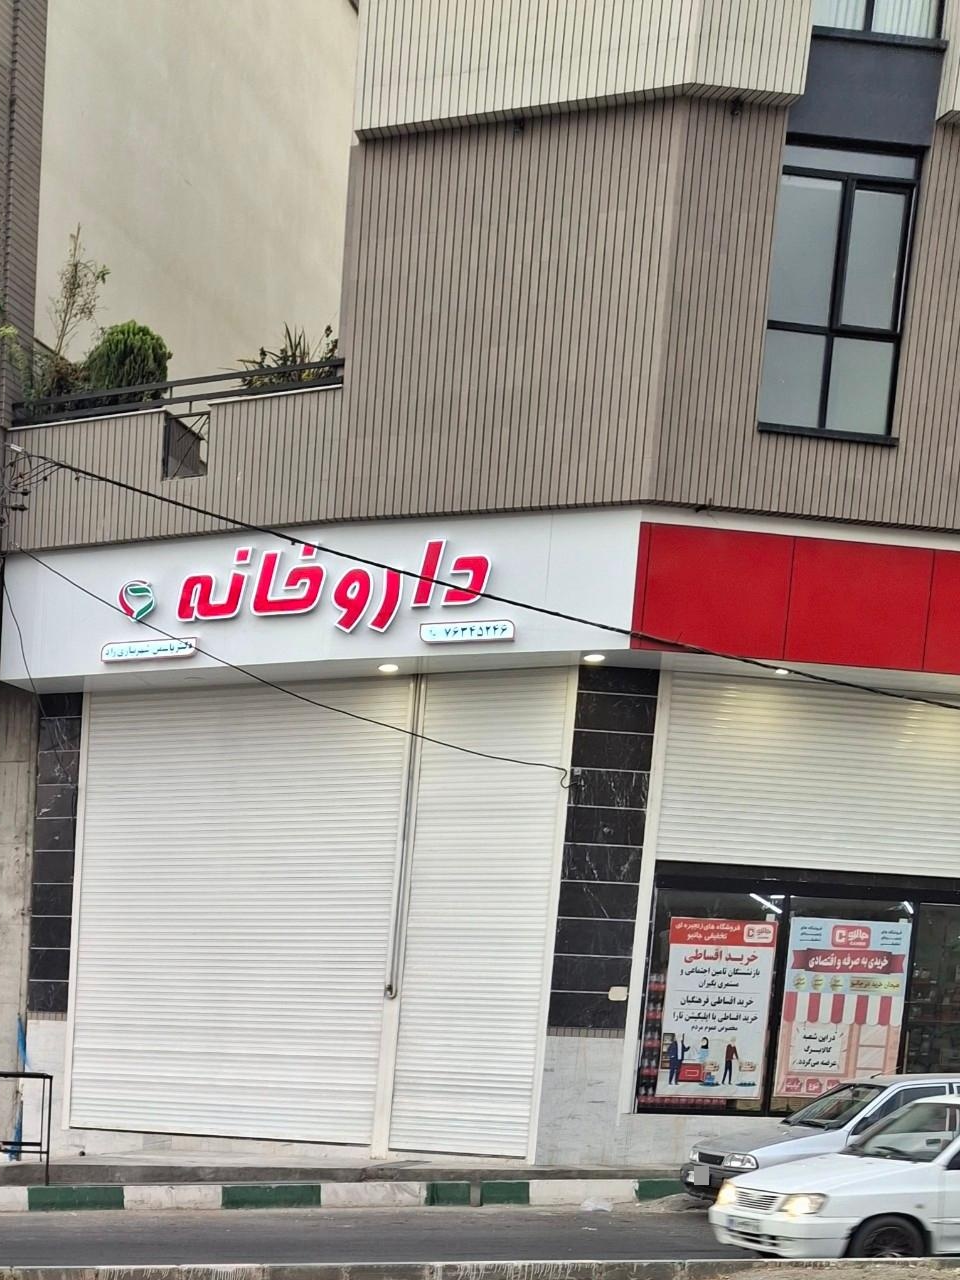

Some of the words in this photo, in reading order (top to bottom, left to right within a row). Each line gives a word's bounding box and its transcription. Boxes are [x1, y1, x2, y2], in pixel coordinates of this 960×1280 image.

[176, 537, 493, 633] داروخانه
[704, 922, 715, 931] های
[716, 922, 741, 933] فروشگاه
[703, 932, 728, 941] تخفیفی
[684, 947, 723, 964] اقساطی
[725, 950, 759, 966] خرید
[808, 952, 837, 968] اقتصادی
[842, 954, 860, 969] صرفه
[861, 958, 867, 968] به
[868, 957, 889, 970] خریدی
[684, 967, 711, 976] اجتماعی
[711, 967, 727, 977] تامین
[698, 979, 717, 989] بگیران
[717, 980, 739, 989] مستمری
[680, 995, 710, 1007] فرهنگیان
[710, 996, 736, 1007] اقساطی
[736, 997, 754, 1008] خرید
[717, 1012, 742, 1023] اقساطی
[742, 1013, 759, 1024] خرید
[690, 1024, 704, 1032] مردم
[704, 1025, 717, 1033] عموم
[717, 1025, 739, 1033] مخصوص
[803, 1032, 817, 1042] شعبه
[818, 1034, 829, 1043] این
[827, 1034, 836, 1043] در
[804, 1045, 833, 1055] کالابرگ
[820, 1060, 837, 1068] عرضه
